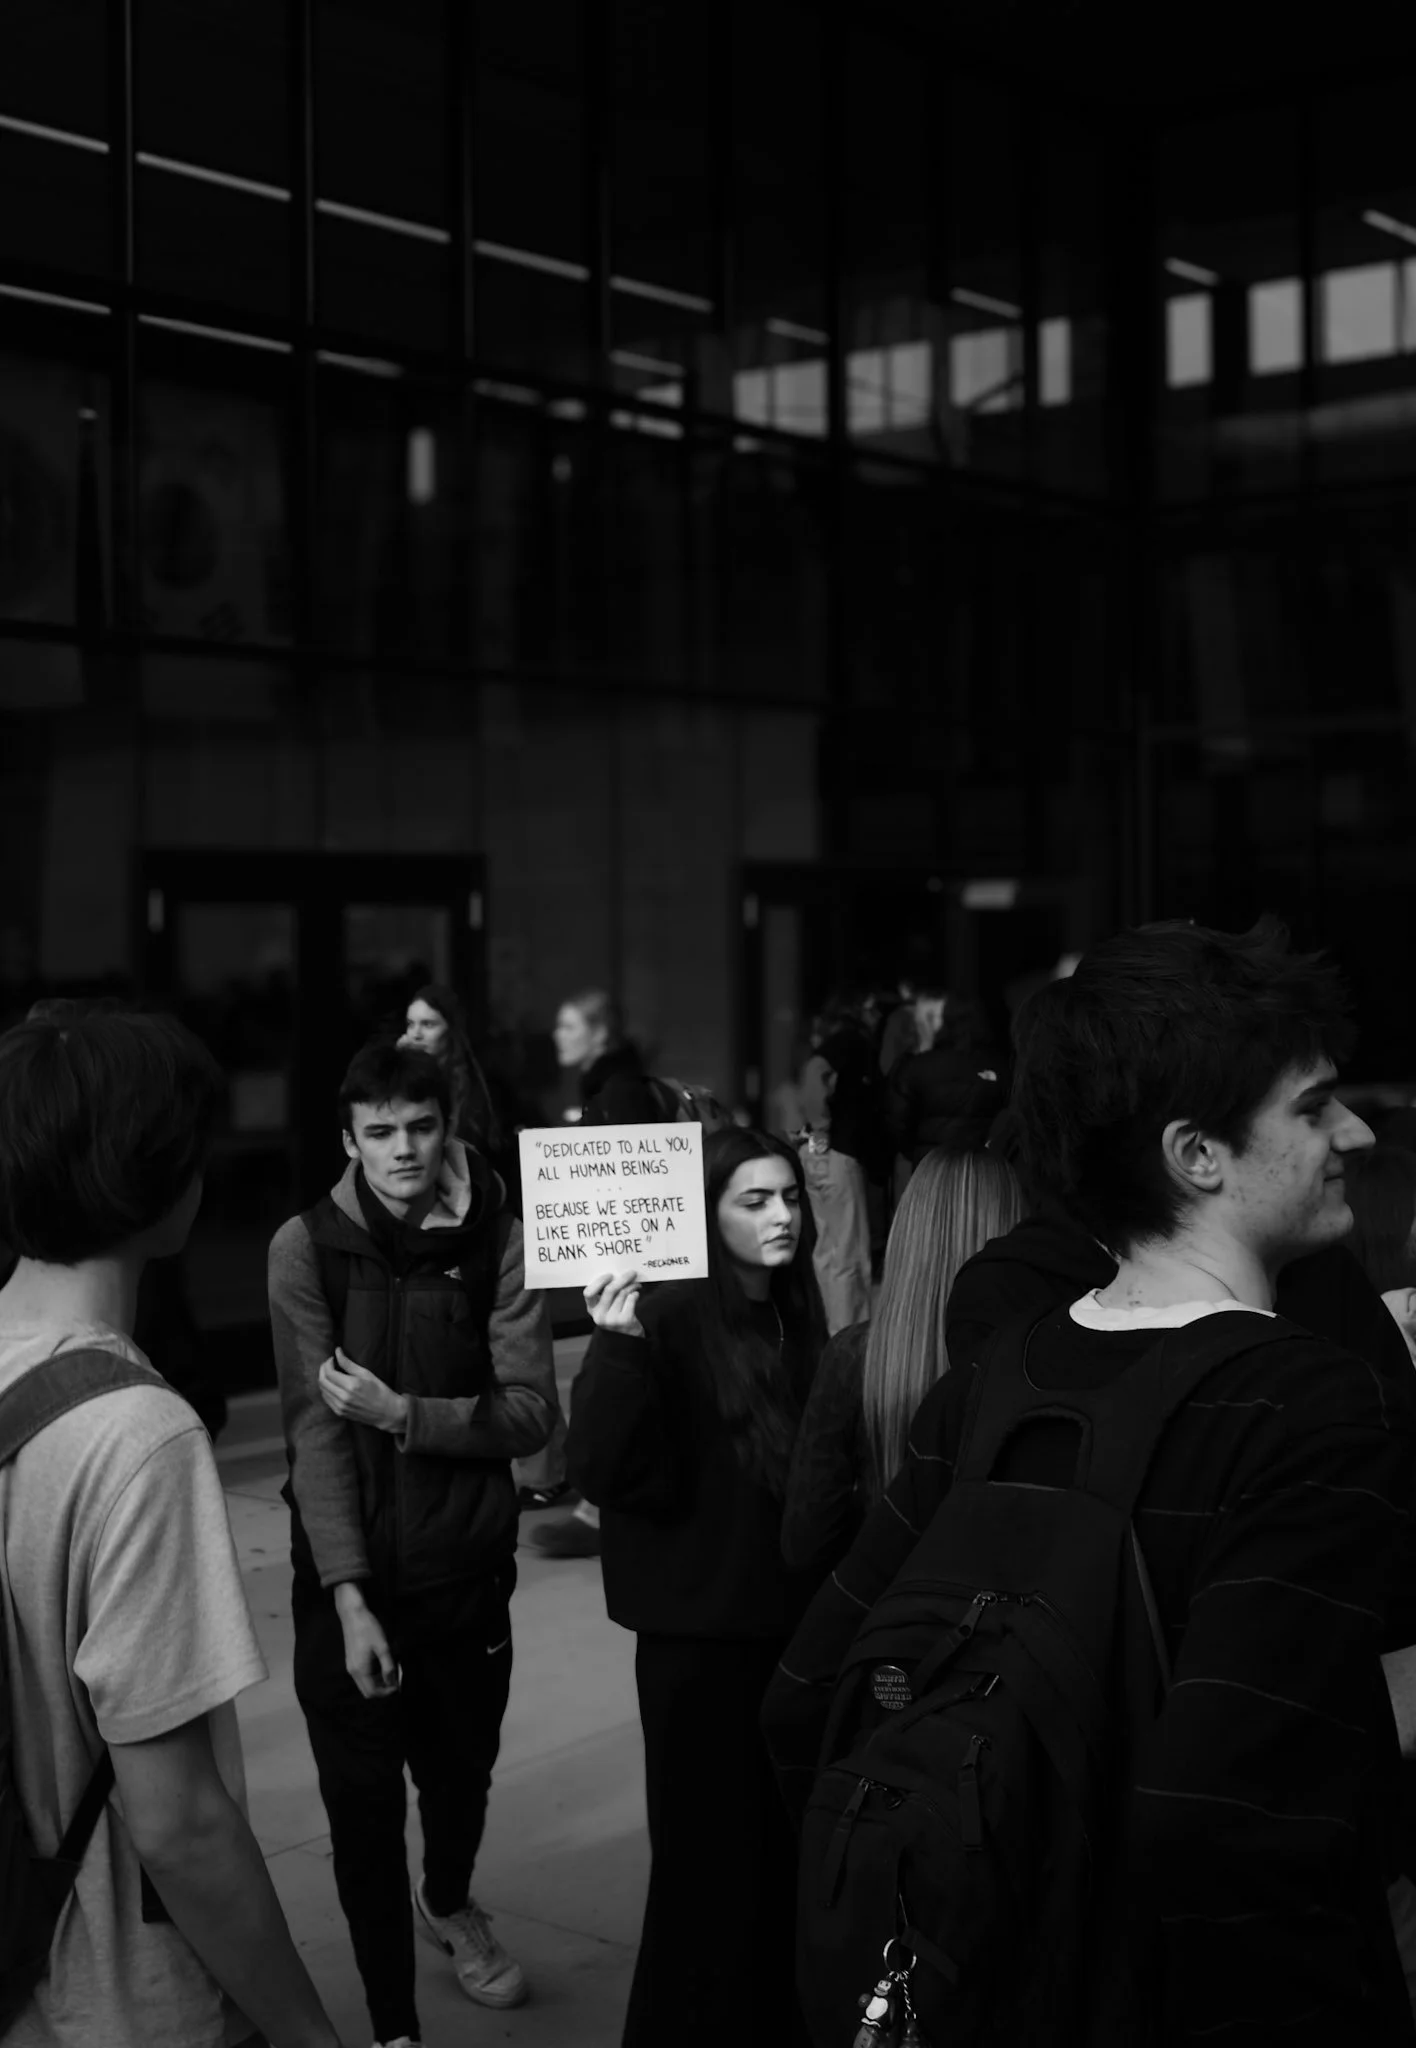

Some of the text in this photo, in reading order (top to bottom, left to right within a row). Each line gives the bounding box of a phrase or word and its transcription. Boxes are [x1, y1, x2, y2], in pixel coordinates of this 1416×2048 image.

[618, 1140, 632, 1154] TO
[638, 1139, 661, 1154] ALL
[666, 1136, 692, 1154] YOU,
[538, 1159, 668, 1180] ALL HUMAN BEINGS
[536, 1197, 684, 1220] BECAUSE WE SEPERATE
[537, 1217, 675, 1241] LIKE RIPPLES ON A
[538, 1244, 587, 1262] BLANK
